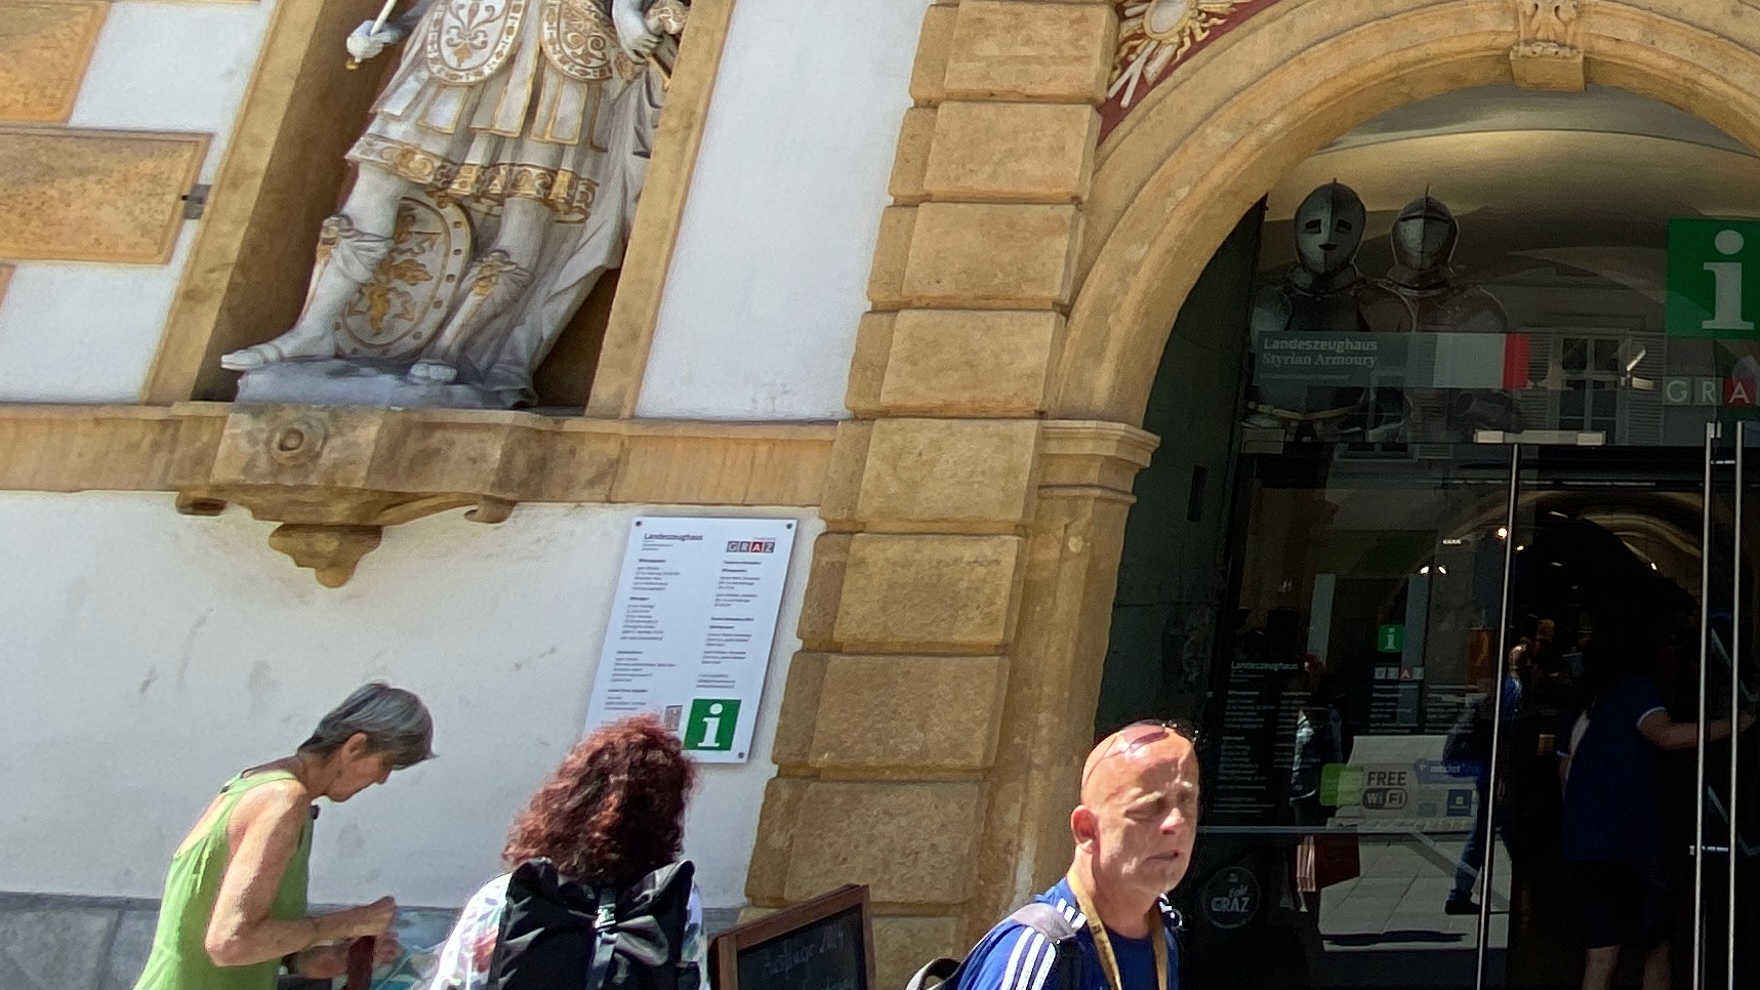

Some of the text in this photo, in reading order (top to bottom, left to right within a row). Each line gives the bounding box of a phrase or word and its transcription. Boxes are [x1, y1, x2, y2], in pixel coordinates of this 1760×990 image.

[1263, 337, 1378, 355] Landeszeughaus
[1262, 353, 1378, 370] Styrian Armoury
[727, 541, 776, 554] GRAZ
[1367, 771, 1408, 786] FREE
